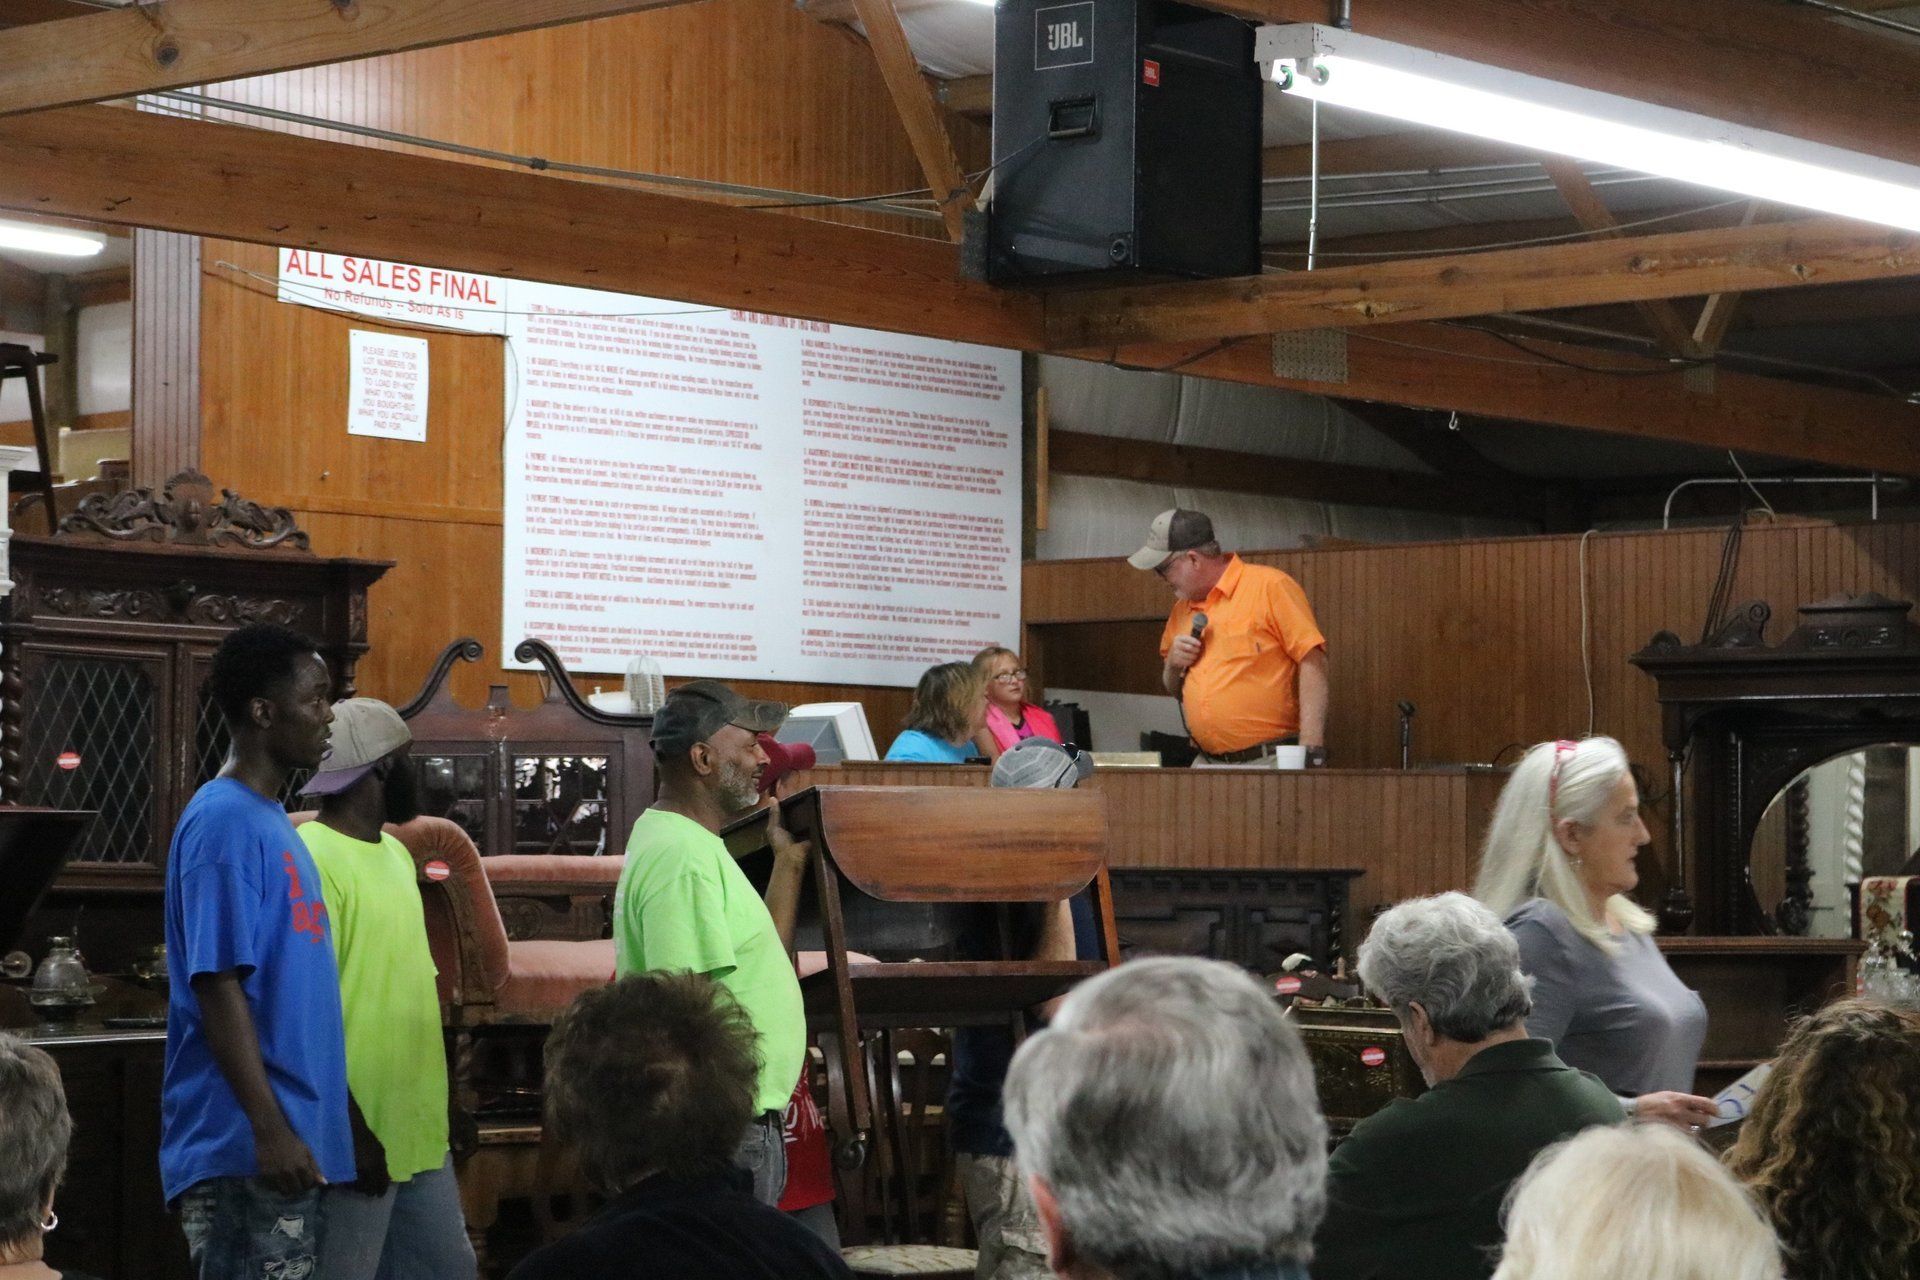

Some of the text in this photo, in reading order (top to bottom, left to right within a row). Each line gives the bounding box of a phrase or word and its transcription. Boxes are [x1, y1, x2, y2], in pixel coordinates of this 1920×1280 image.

[1048, 21, 1083, 51] JBL
[1144, 66, 1157, 79] JBL
[287, 249, 497, 305] ALL SALES FINAL
[325, 287, 341, 301] No
[345, 290, 392, 309] Refunds
[408, 300, 433, 315] Sold
[437, 306, 451, 318] As
[455, 309, 464, 320] Is
